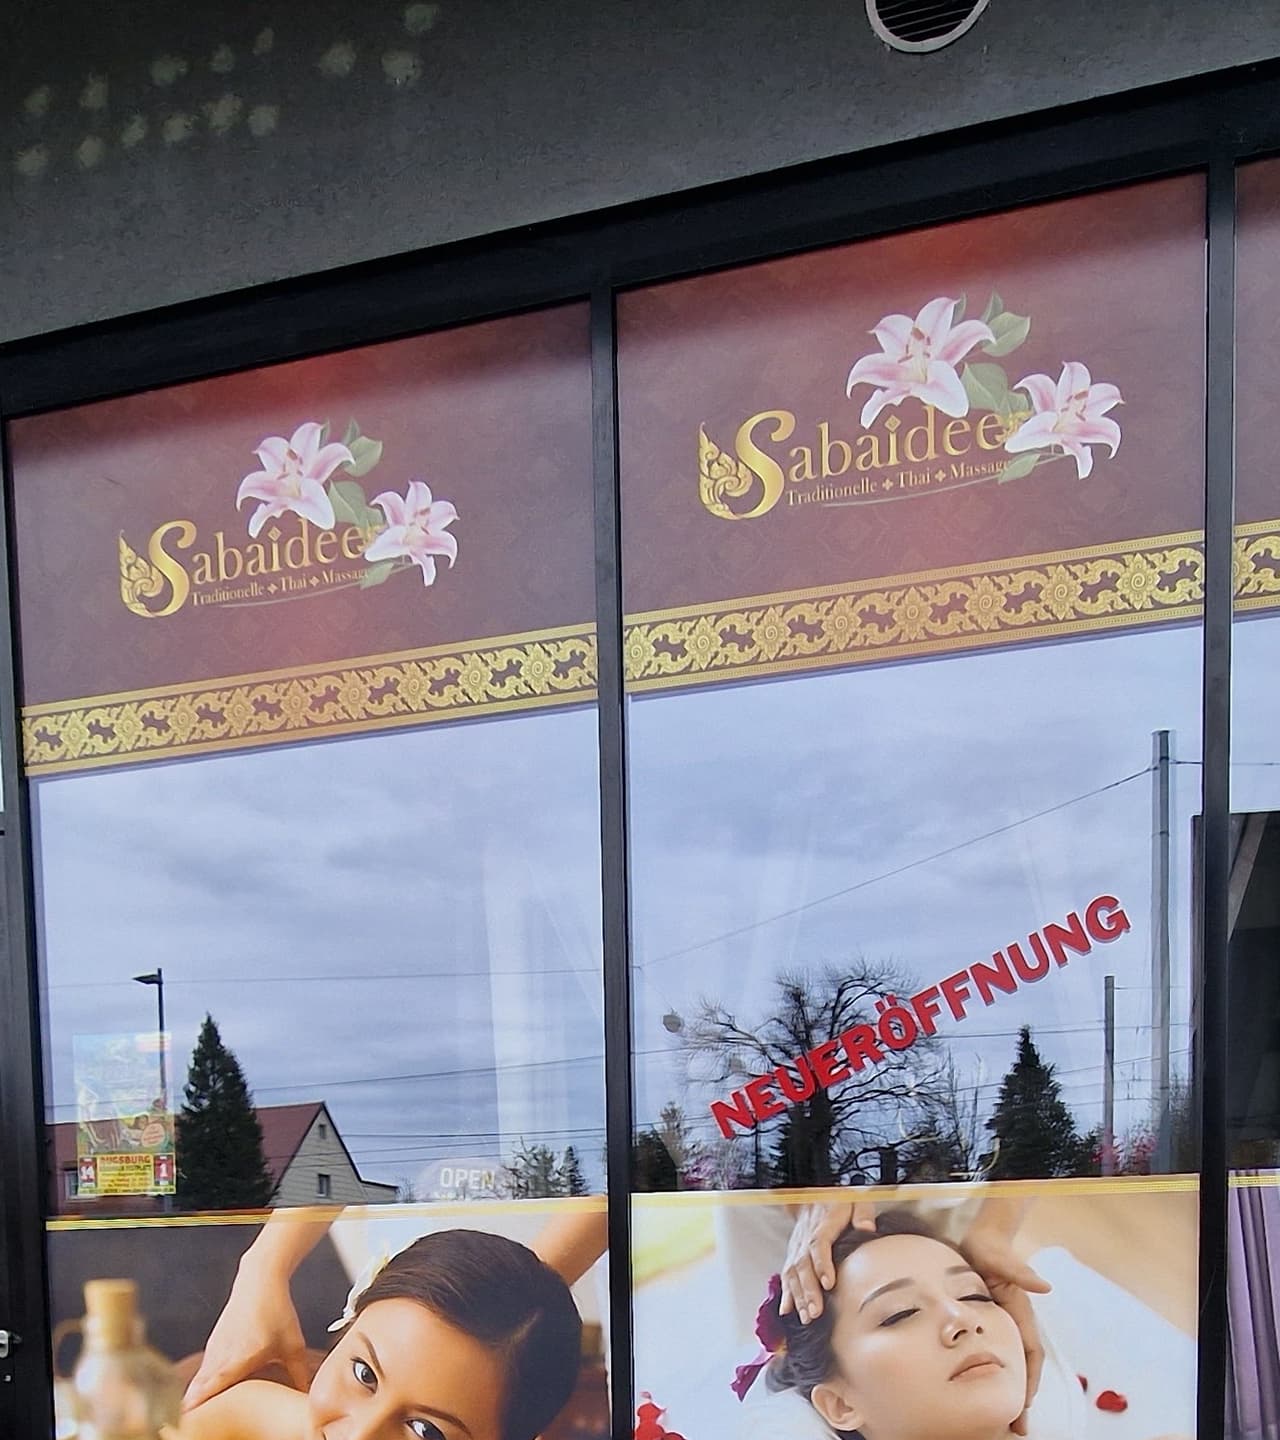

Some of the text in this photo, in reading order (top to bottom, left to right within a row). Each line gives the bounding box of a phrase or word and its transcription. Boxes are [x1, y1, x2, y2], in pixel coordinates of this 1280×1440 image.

[698, 406, 1008, 520] Sabaidee
[787, 477, 877, 506] Traditionelle
[898, 467, 932, 489] Thai
[120, 518, 367, 618] Sabaidee
[192, 581, 264, 606] Traditionelle
[280, 574, 307, 592] Thai
[710, 894, 1131, 1140] NEUERÖFFNUNG
[440, 1167, 496, 1190] OPEN
